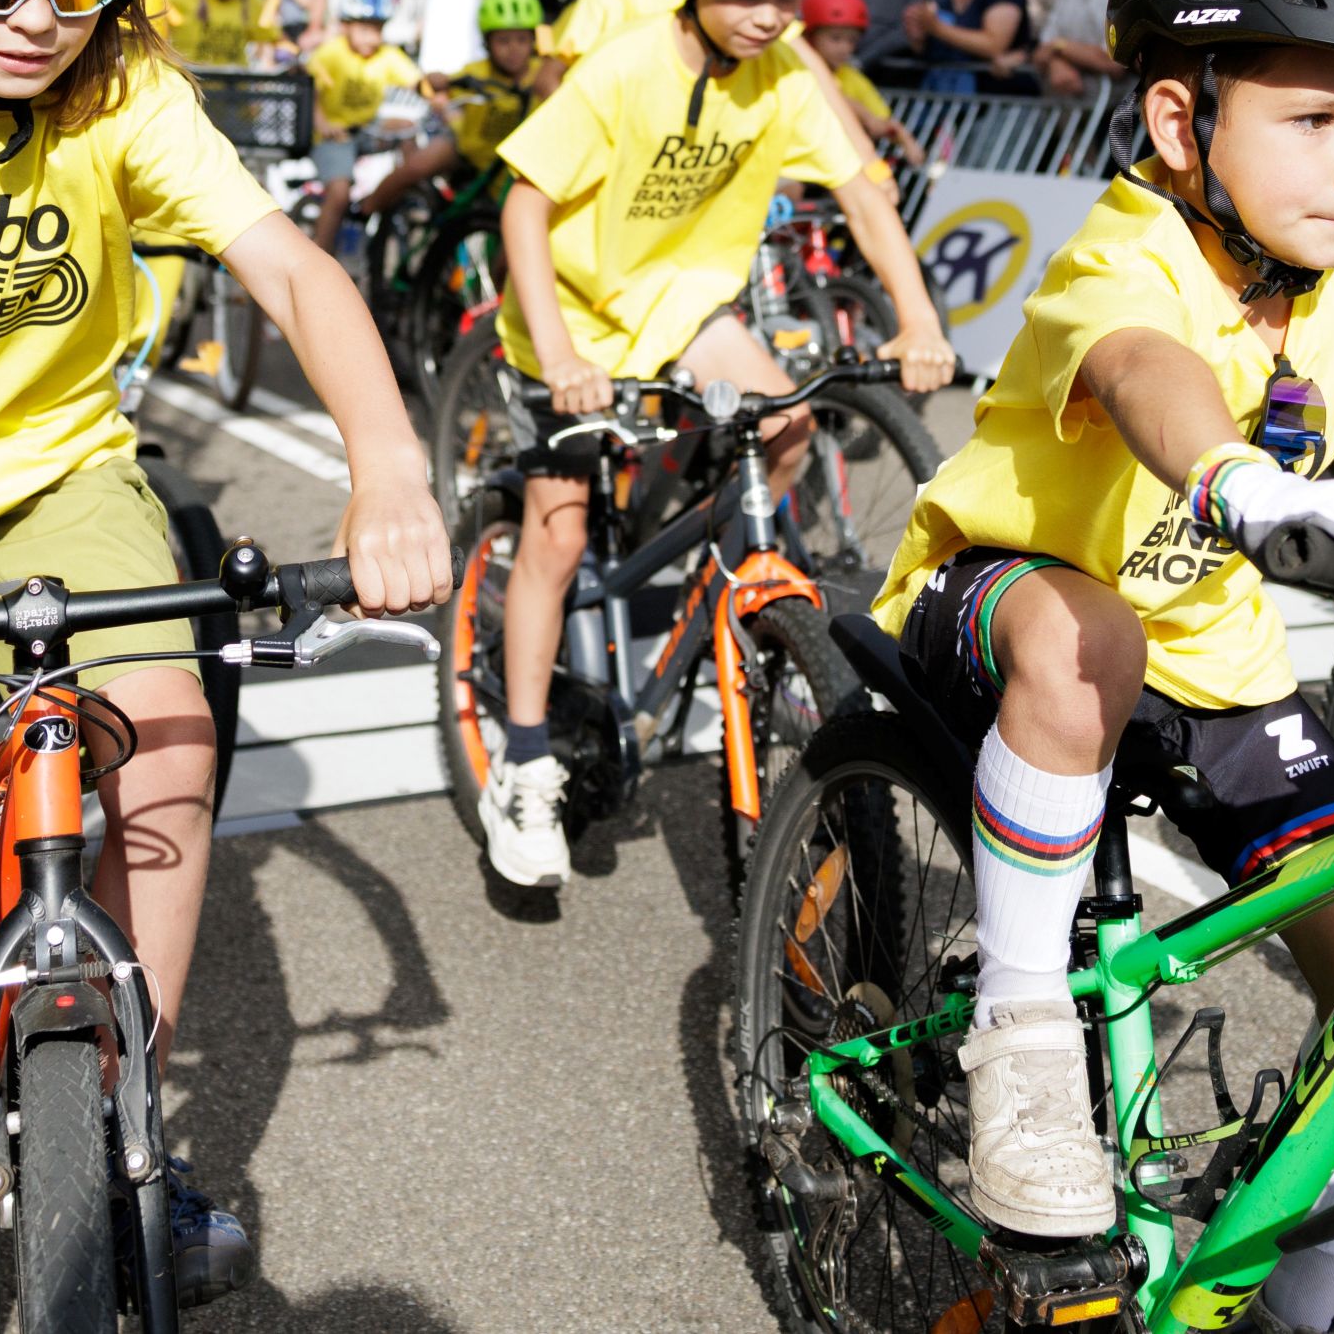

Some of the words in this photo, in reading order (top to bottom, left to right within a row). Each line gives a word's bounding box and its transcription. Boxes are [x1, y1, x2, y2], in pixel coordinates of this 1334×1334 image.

[1172, 8, 1242, 25] LAZER
[625, 205, 685, 220] RACE
[1284, 754, 1330, 779] ZWIFT
[739, 998, 754, 1057] JACK
[1147, 1130, 1209, 1152] CUBE
